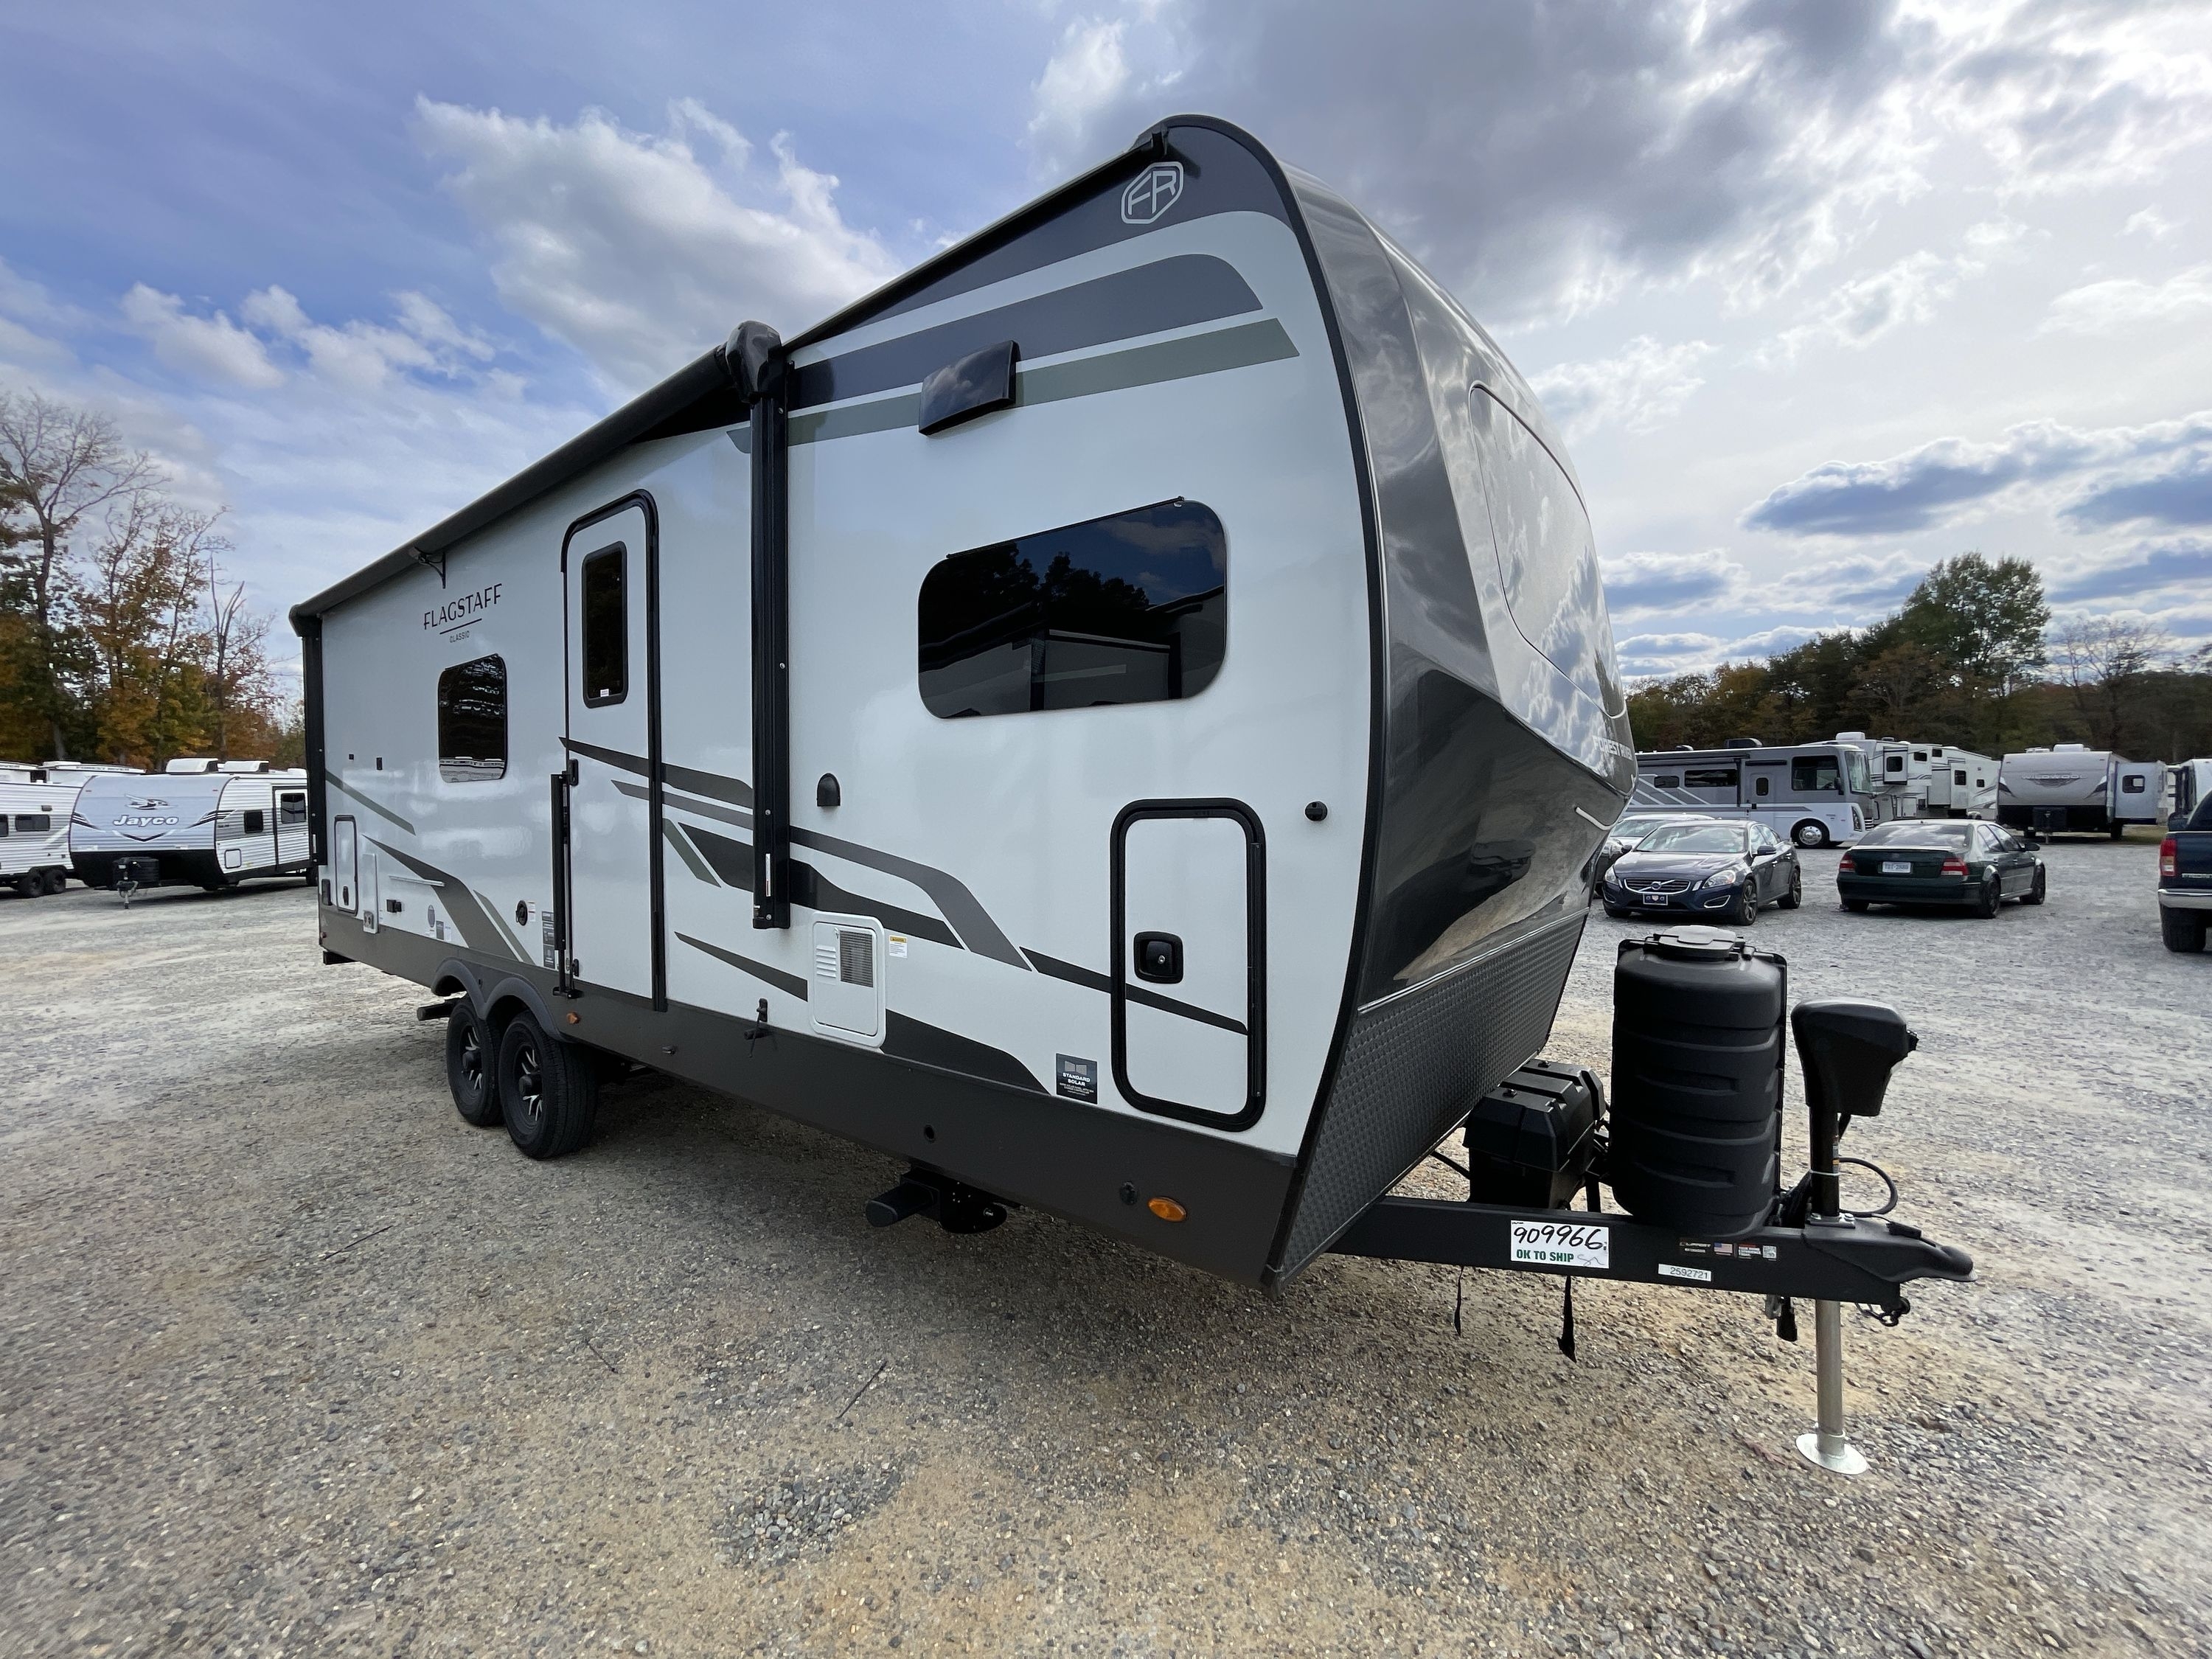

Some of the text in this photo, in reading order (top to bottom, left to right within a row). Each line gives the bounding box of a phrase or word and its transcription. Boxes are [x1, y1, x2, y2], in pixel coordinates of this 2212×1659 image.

[423, 582, 502, 630] FLAGSTAFF
[449, 630, 470, 644] CLASSIC
[113, 815, 179, 827] Jayco
[1062, 1072, 1091, 1082] STANDARD
[1068, 1078, 1085, 1087] SOLAR
[1514, 1225, 1603, 1250] 909966
[1516, 1249, 1531, 1259] OK
[1534, 1251, 1546, 1261] TO
[1549, 1251, 1574, 1262] SHIP
[1670, 1267, 1708, 1280] 2592721
